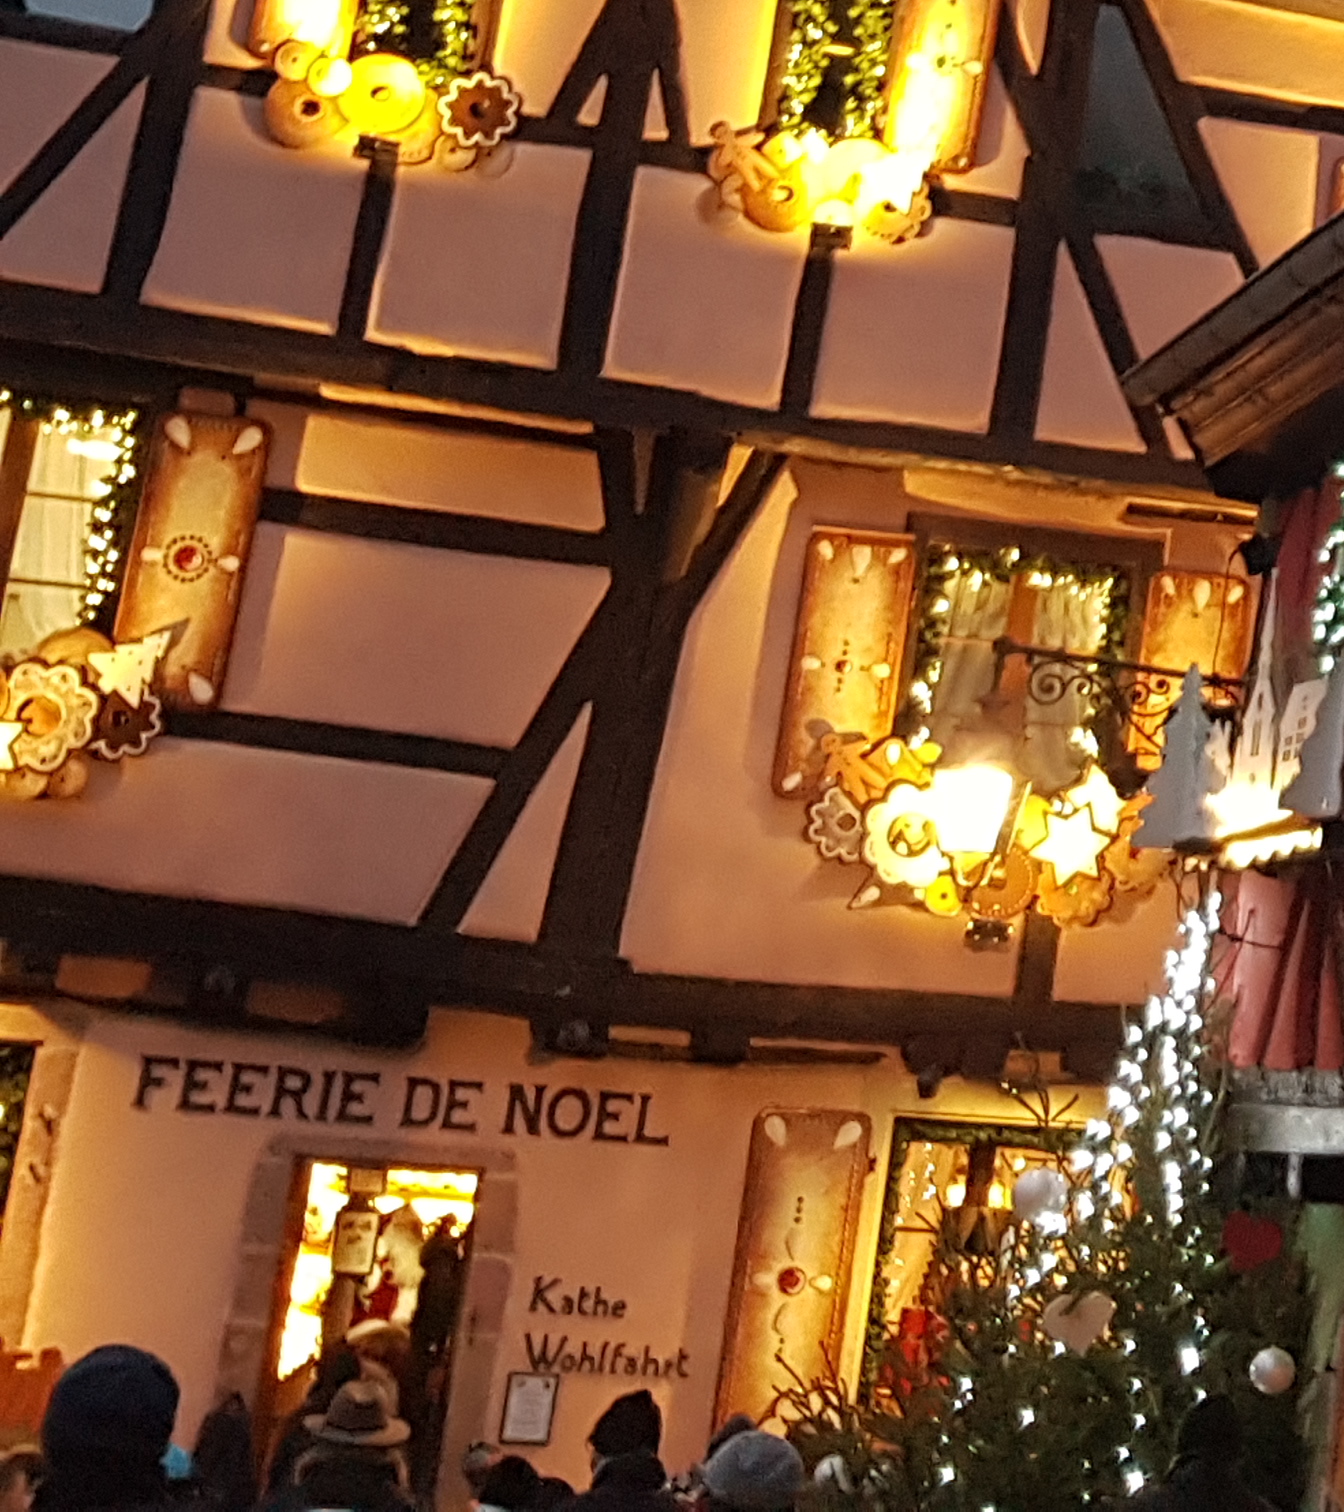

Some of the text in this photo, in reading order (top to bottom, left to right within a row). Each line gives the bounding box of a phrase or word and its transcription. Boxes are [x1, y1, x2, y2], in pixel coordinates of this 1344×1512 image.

[131, 1053, 670, 1147] FEERIE DE NOEL
[528, 1274, 628, 1319] Kathe
[524, 1332, 690, 1378] Wohlfahrt
